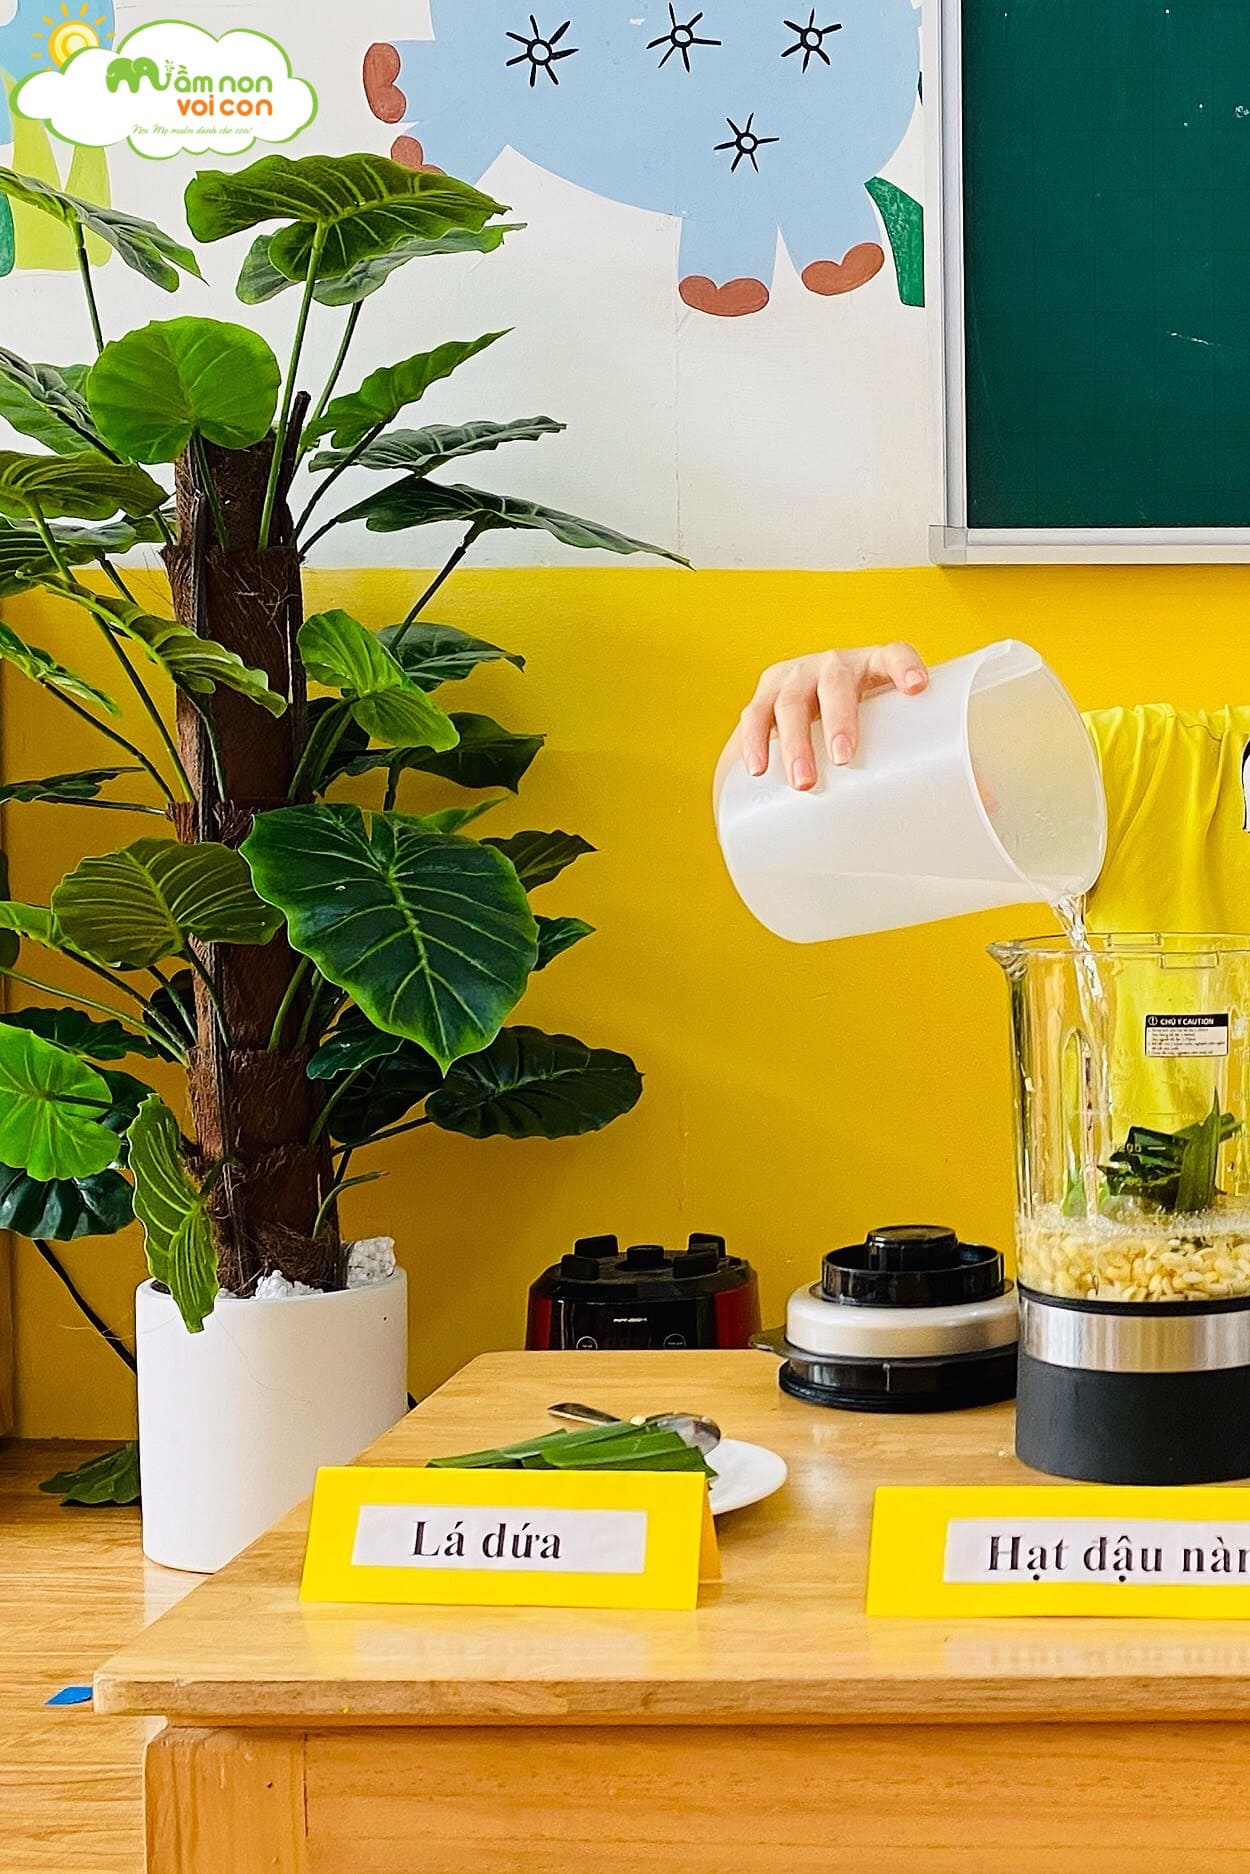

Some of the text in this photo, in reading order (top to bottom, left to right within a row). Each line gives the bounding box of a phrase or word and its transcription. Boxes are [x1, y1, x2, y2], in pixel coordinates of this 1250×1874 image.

[1182, 1017, 1214, 1026] CAUTION
[412, 1520, 561, 1560] Lá dứa
[988, 1535, 1067, 1582] Hạt
[1083, 1535, 1163, 1583] đậu
